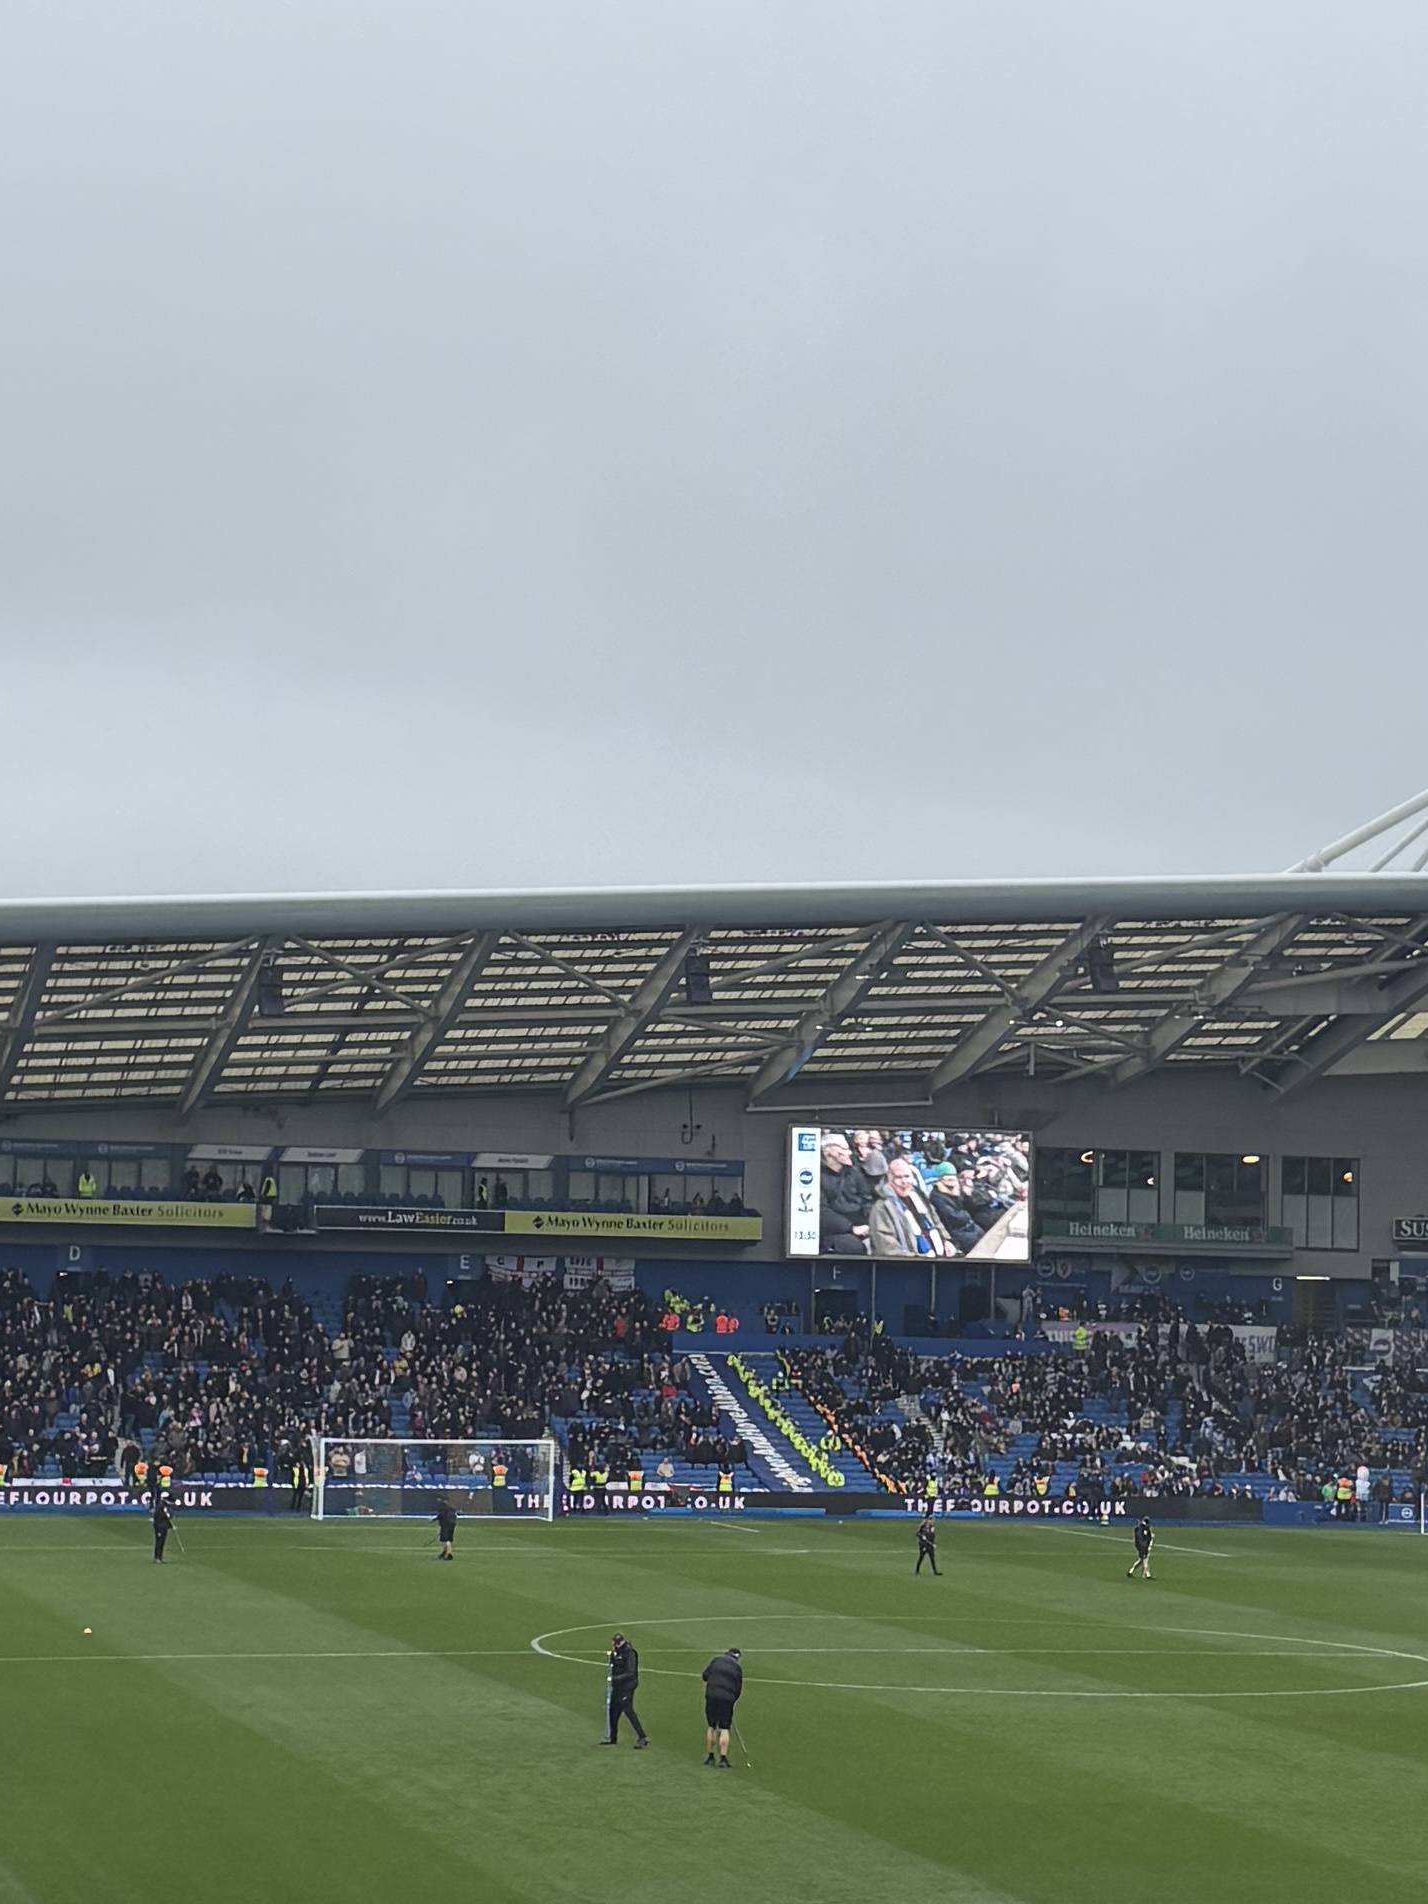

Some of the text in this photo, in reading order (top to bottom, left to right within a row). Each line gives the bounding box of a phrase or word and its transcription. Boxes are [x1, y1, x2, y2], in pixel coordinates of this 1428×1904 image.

[26, 1202, 225, 1219] Mayo Wynne Baxter Solicitors
[546, 1217, 730, 1233] Mayo Wynne Baxter Solicitors
[1069, 1222, 1136, 1238] Heineken
[1183, 1225, 1250, 1241] Heineken
[69, 1247, 81, 1261] D
[460, 1254, 470, 1270] E
[1272, 1278, 1282, 1291] G
